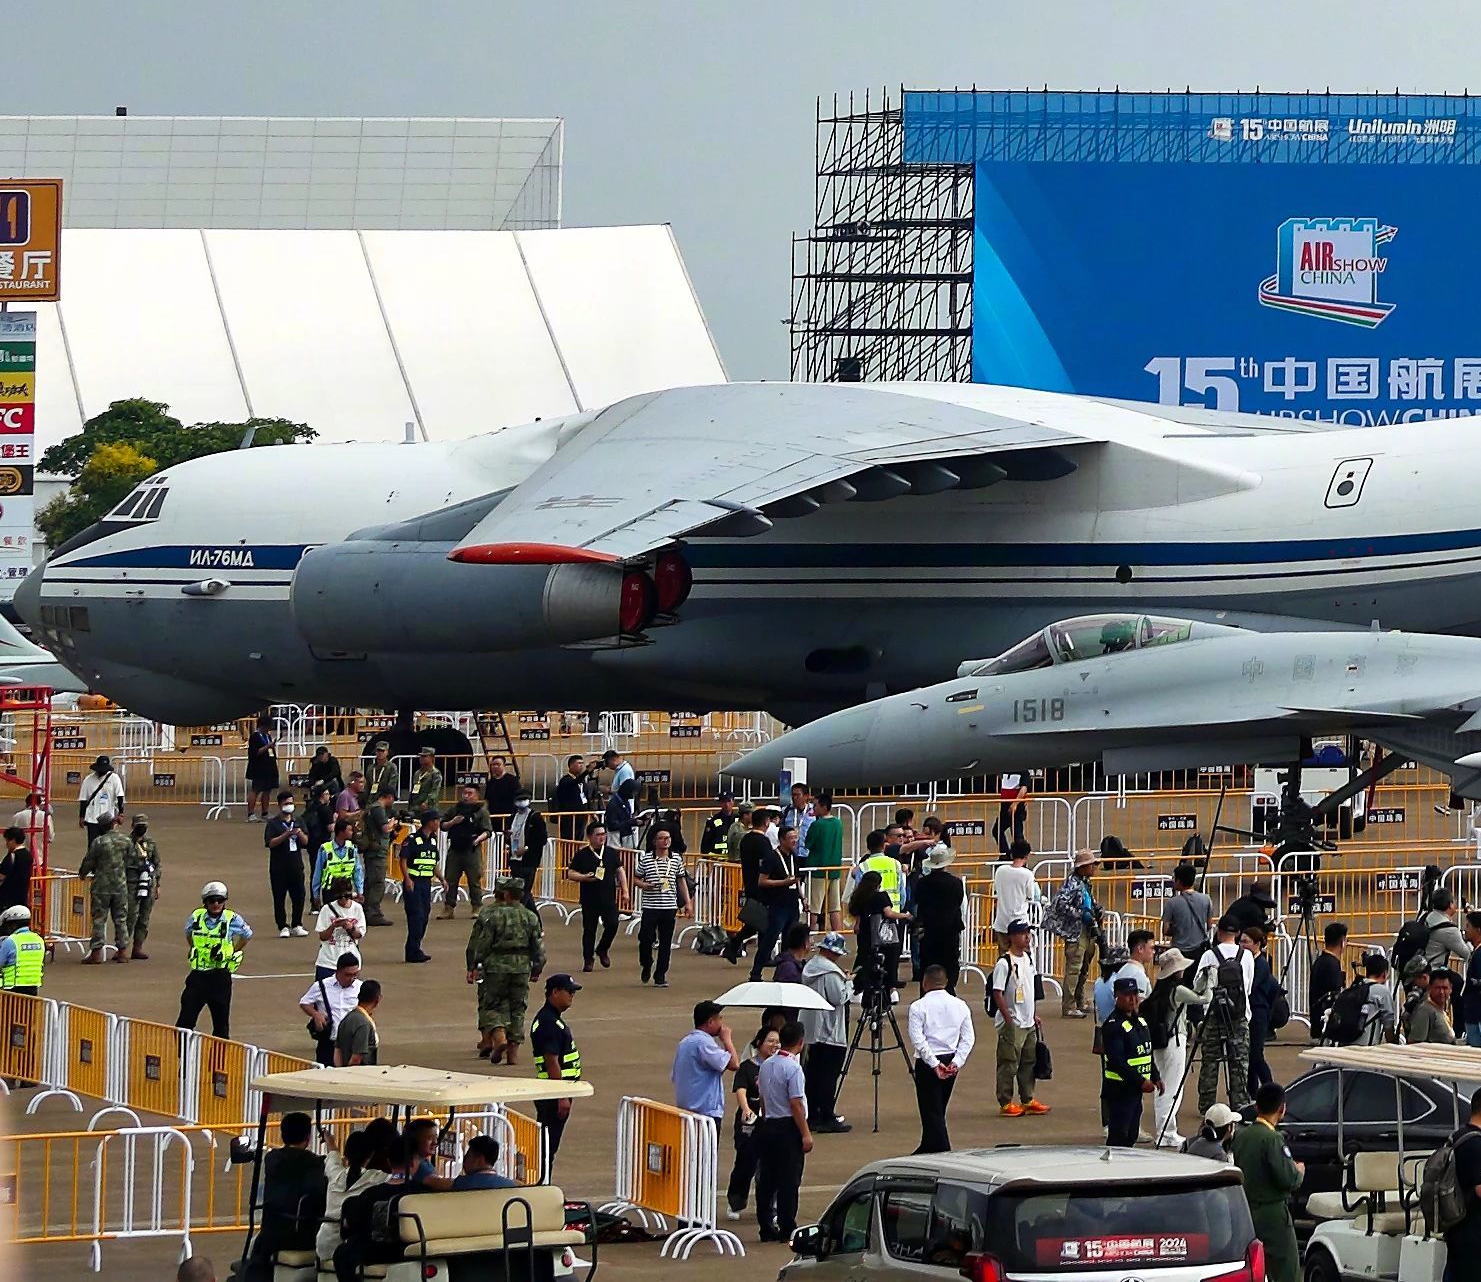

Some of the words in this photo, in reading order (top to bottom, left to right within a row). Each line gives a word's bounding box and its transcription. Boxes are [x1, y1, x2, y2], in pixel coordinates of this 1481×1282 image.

[1268, 118, 1329, 132] 中国航展
[1348, 118, 1421, 135] Unilumin
[1423, 119, 1457, 135] 洲明
[1301, 241, 1387, 271] AIRSHOW
[1301, 271, 1356, 285] CHINA
[189, 549, 255, 567] ИЛ-76МД
[1013, 698, 1065, 724] 1518
[947, 826, 983, 836] 中国珠海
[1160, 820, 1195, 829] 中国珠海
